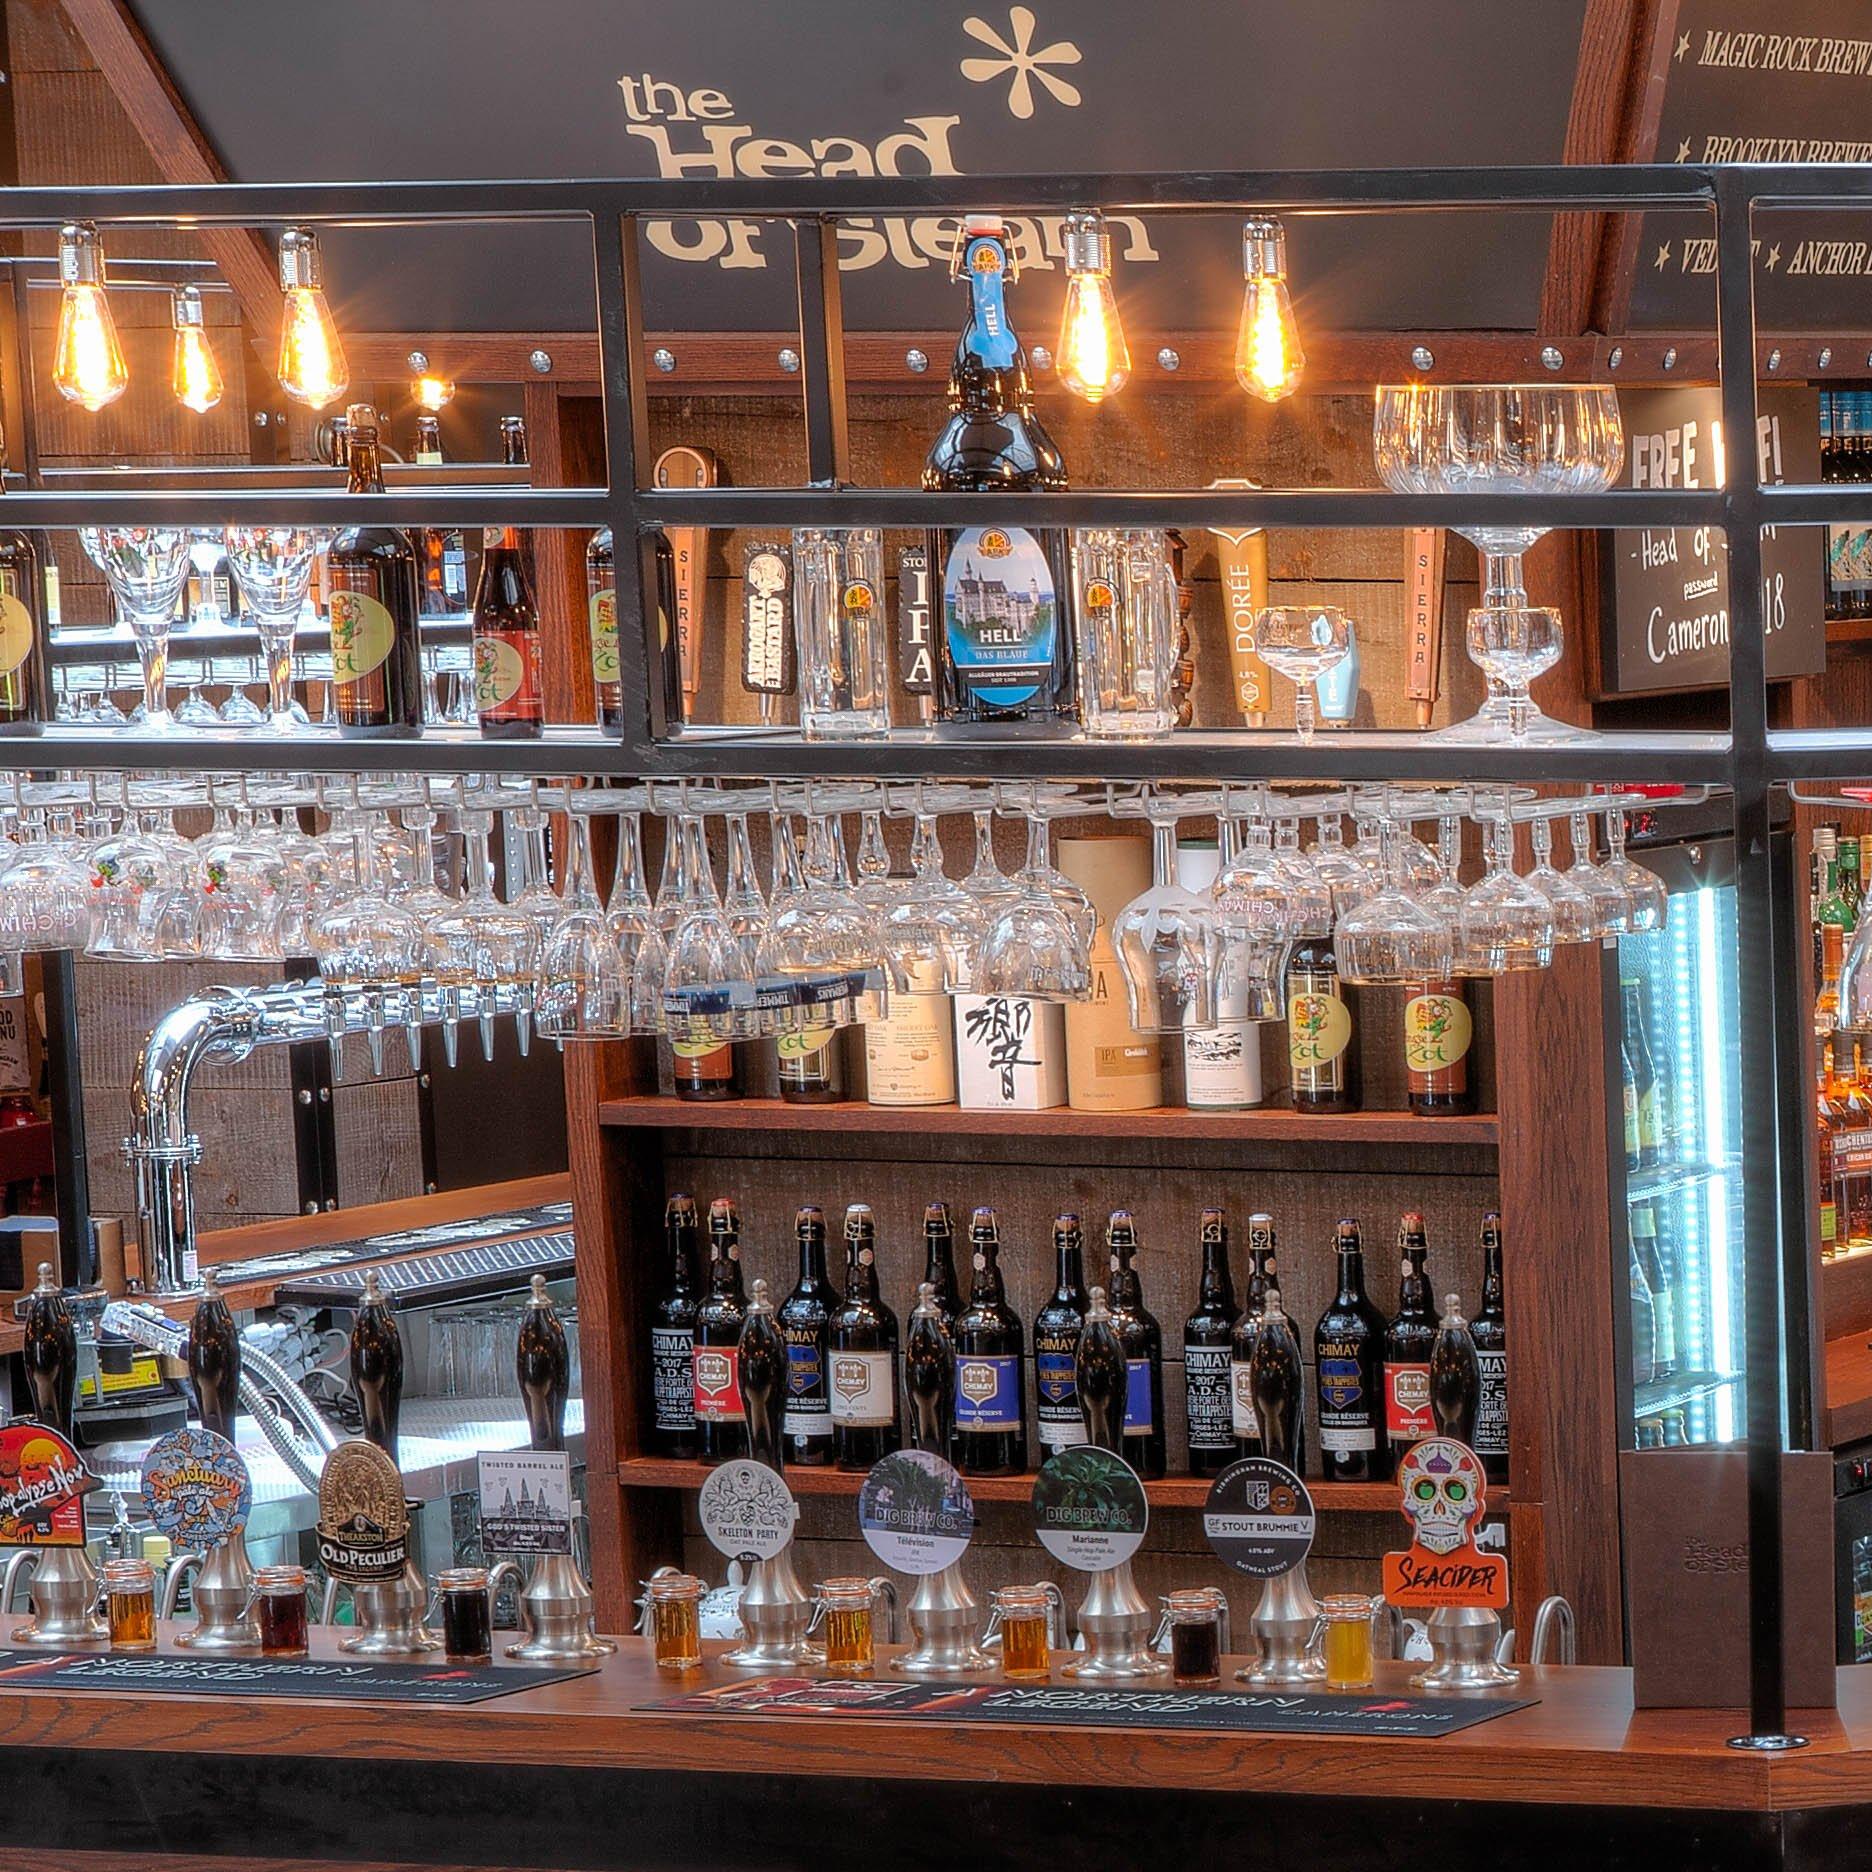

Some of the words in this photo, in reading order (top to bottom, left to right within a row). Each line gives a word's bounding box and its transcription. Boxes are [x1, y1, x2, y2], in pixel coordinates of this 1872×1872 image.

[1699, 31, 1765, 68] MAGIC
[1761, 39, 1818, 72] ROCK
[617, 73, 735, 121] the
[626, 115, 967, 180] Head
[1703, 135, 1807, 164] BROOKLYN
[1786, 243, 1868, 276] ANCHOR
[985, 303, 1000, 337] HELL
[1632, 420, 1700, 489] FREE
[1683, 571, 1719, 600] password
[678, 550, 690, 657] SIERRA
[1227, 563, 1256, 654] DORÉE
[1414, 554, 1428, 664] SIERRA
[979, 629, 1024, 643] HELL
[975, 650, 994, 660] DAS
[996, 650, 1028, 660] BLAUE
[1408, 1045, 1449, 1063] Zot
[651, 1334, 694, 1351] CHIMAY
[1036, 1337, 1077, 1351] CHIMAY
[1319, 1344, 1360, 1356] CHIMAY
[661, 1358, 683, 1369] 2017
[1185, 1352, 1232, 1368] CHIMAY
[698, 1371, 729, 1382] CHIMAY
[836, 1377, 866, 1386] CHIMAY
[1195, 1376, 1215, 1387] 2017
[963, 1382, 994, 1391] CHIMAY
[1398, 1390, 1430, 1398] CHIMAY
[661, 1411, 688, 1420] CHIMAY
[1340, 1411, 1370, 1420] RÉSERVE
[1193, 1430, 1222, 1439] CHIMAY
[481, 1461, 515, 1470] TWISTED
[516, 1461, 548, 1470] BARREL
[550, 1462, 565, 1471] ALE
[48, 1454, 84, 1496] Now
[149, 1463, 242, 1501] Sanctuary
[1215, 1464, 1257, 1495] BIRMINGHAM
[1257, 1464, 1292, 1486] BREWING
[176, 1486, 198, 1498] pale
[197, 1486, 216, 1498] ale
[874, 1506, 900, 1525] DIG
[900, 1508, 935, 1530] BREW
[934, 1511, 958, 1530] CO.
[1045, 1506, 1074, 1523] DIG
[1073, 1507, 1109, 1524] BREW
[1108, 1508, 1133, 1525] CO.
[486, 1523, 509, 1532] GOD'S
[509, 1523, 540, 1532] TWISTED
[540, 1523, 566, 1533] SISTER
[717, 1525, 754, 1539] SKELETON
[756, 1528, 779, 1541] PARTY
[1221, 1520, 1255, 1532] STOUT
[1256, 1521, 1299, 1533] BRUMMIE
[338, 1532, 383, 1543] THEAKSTON
[896, 1535, 936, 1548] Télévision
[1072, 1533, 1110, 1546] Marianne
[320, 1543, 348, 1564] OLD
[349, 1547, 405, 1566] PECULIER
[1235, 1560, 1267, 1574] OATMEAL
[1267, 1560, 1289, 1573] STOUT
[55, 1665, 267, 1682] LEGEND
[70, 1657, 374, 1680] NORTHERN
[981, 1697, 1201, 1714] LEGEND
[986, 1688, 1308, 1709] NORTHERN
